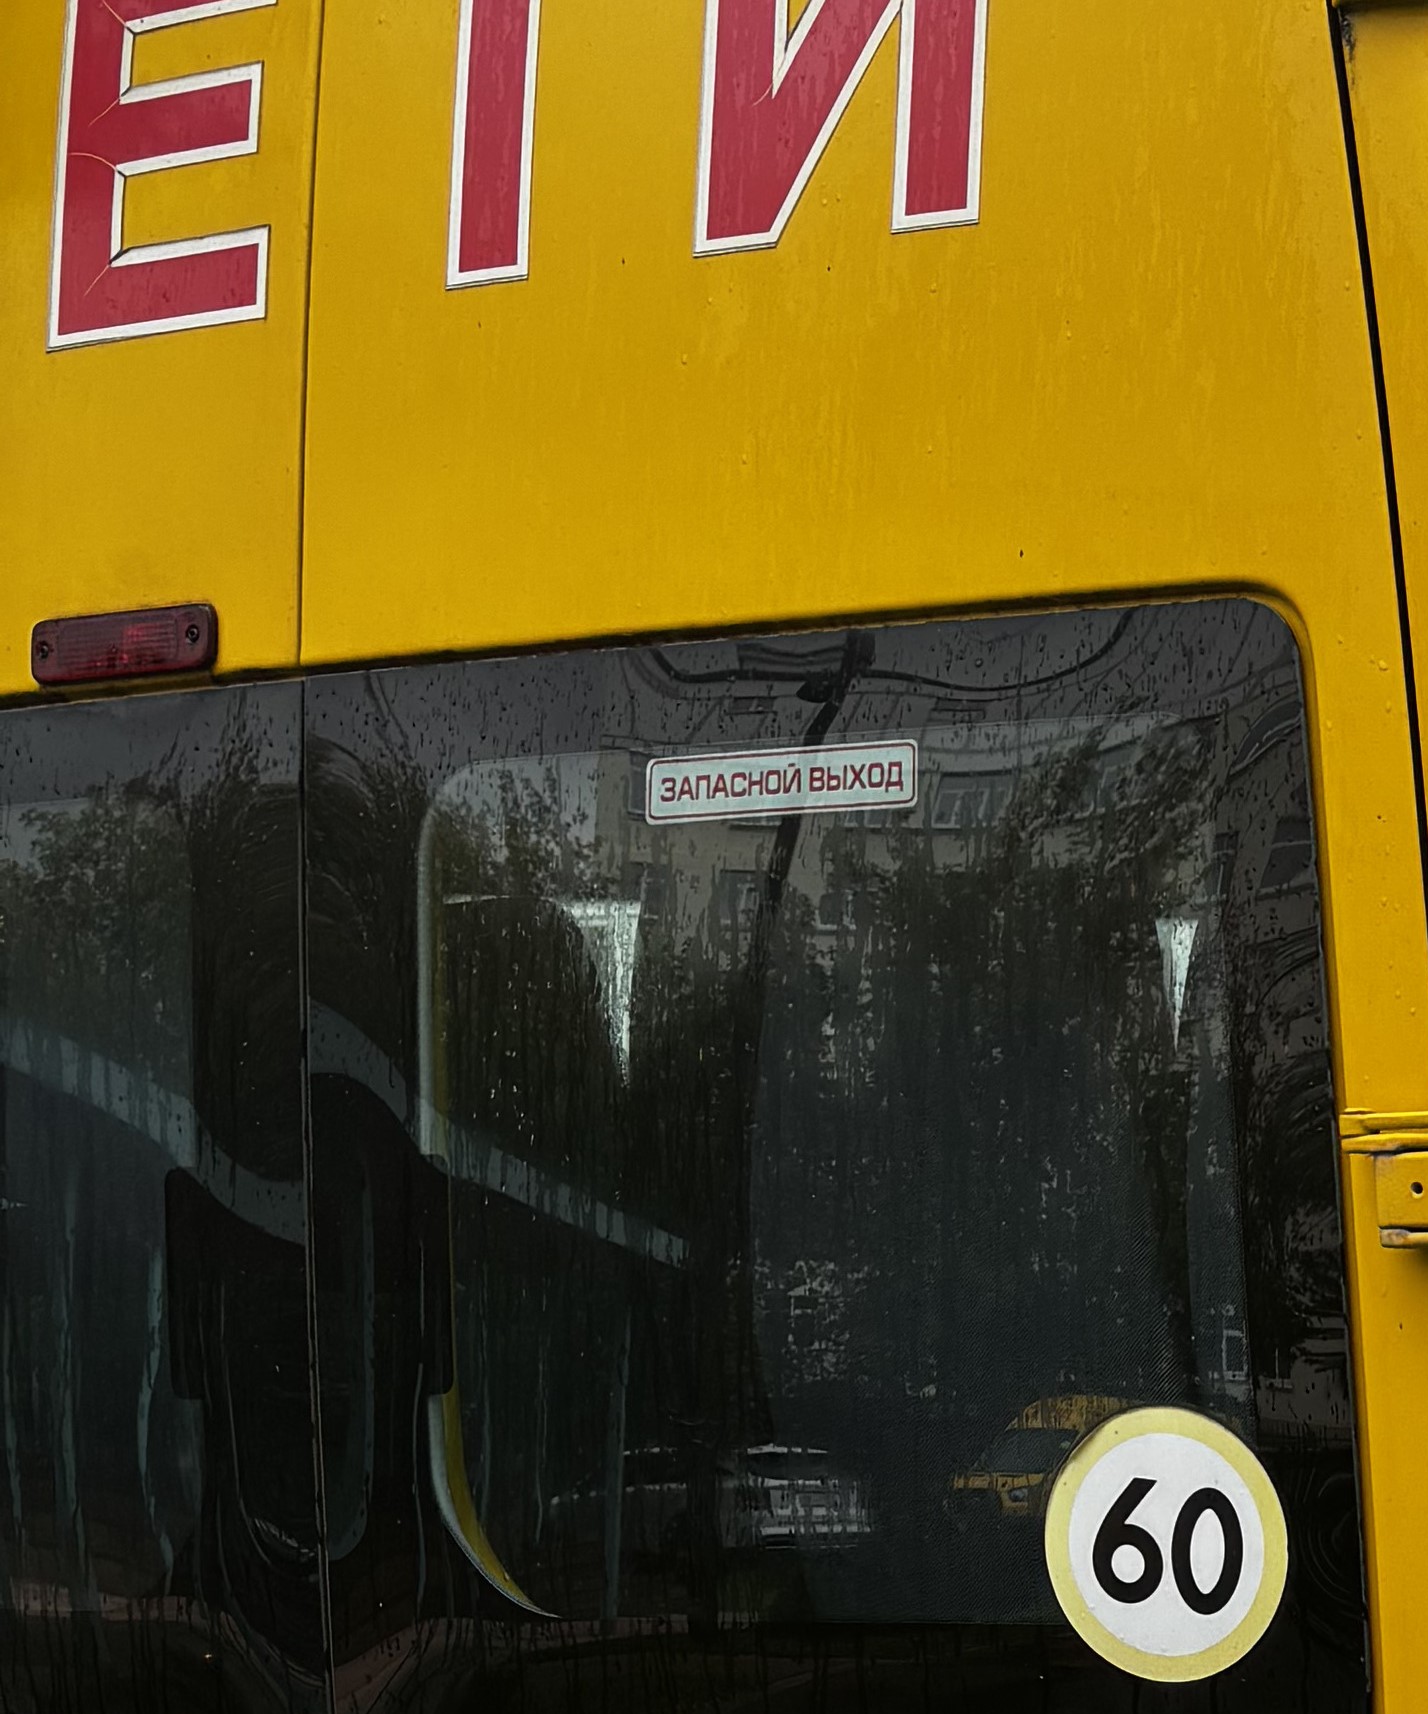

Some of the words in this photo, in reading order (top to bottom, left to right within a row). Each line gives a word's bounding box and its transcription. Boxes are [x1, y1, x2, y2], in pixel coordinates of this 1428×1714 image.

[660, 763, 801, 802] ЗАПАСНОЙ
[808, 761, 904, 793] ВЫХОД
[1092, 1477, 1244, 1615] 60
